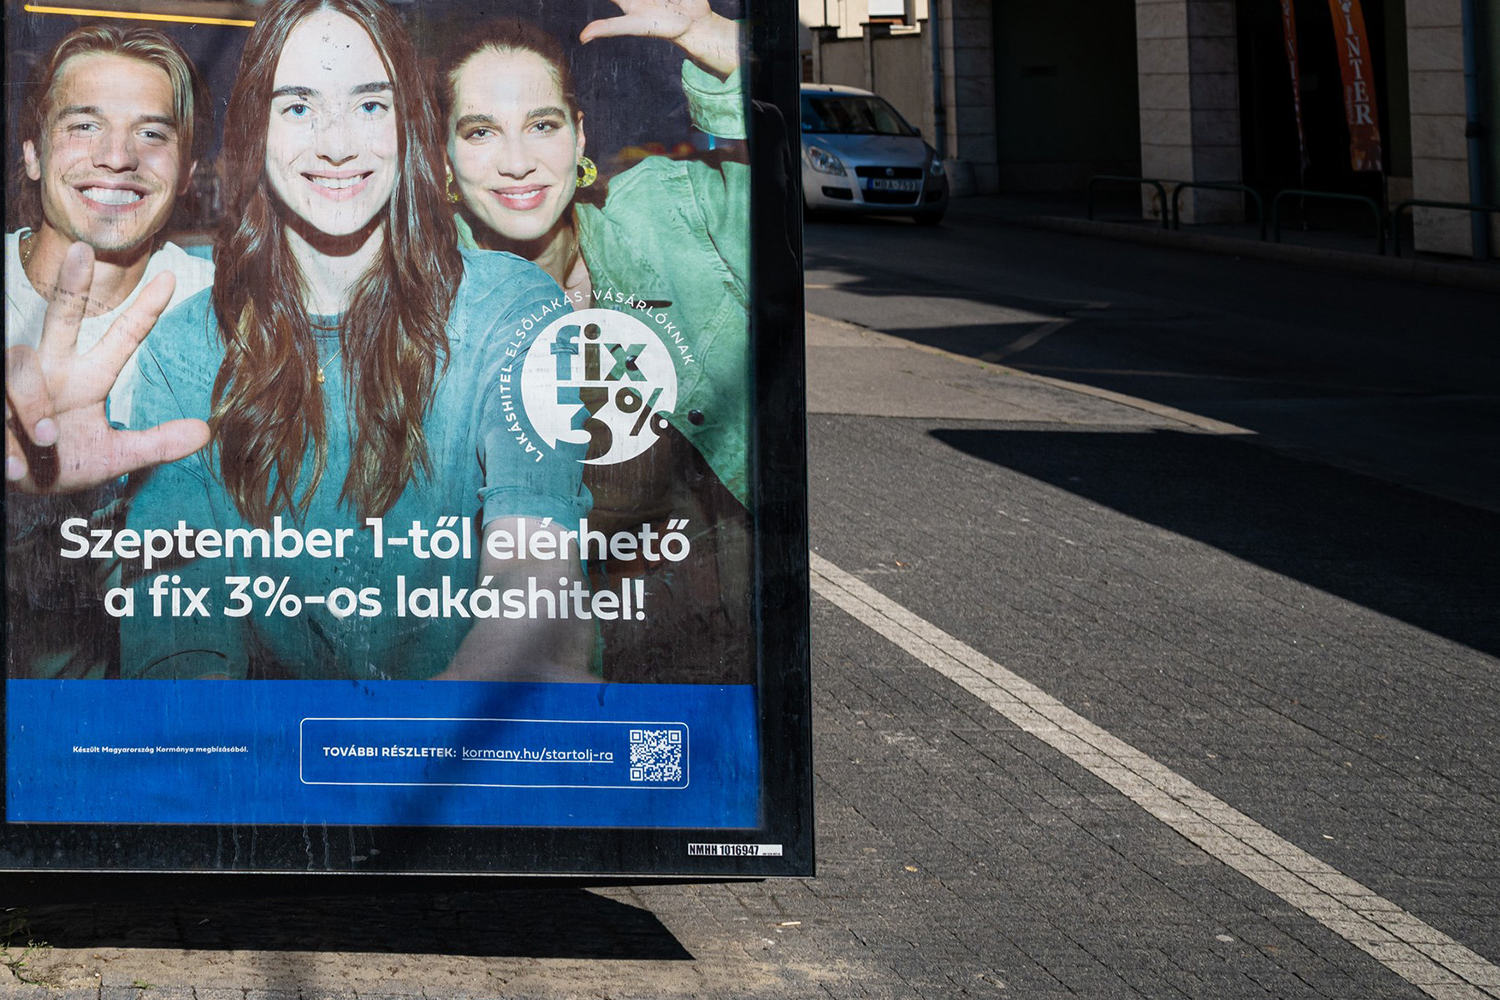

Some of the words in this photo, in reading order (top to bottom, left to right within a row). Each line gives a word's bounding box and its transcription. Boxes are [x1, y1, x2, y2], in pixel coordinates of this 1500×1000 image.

[549, 322, 649, 382] fix
[500, 363, 544, 463] LAKÁSHITEL
[555, 385, 674, 460] 3%
[60, 516, 354, 570] Szeptember
[365, 515, 472, 559] 1-től
[486, 517, 690, 562] elérhető
[104, 587, 134, 618] a
[148, 575, 211, 618] fix
[223, 575, 382, 618] 3%-os
[397, 575, 646, 621] lakáshitel!
[72, 745, 100, 754] Készült
[101, 745, 155, 755] Magyarország
[155, 745, 195, 755] Kormánya
[322, 743, 378, 757] TOVÁBBI
[381, 743, 457, 758] RÉSZLETEK:
[462, 746, 614, 763] kormany.hu/startolj-ra
[689, 844, 718, 855] NMHH
[719, 844, 760, 856] 1016947
